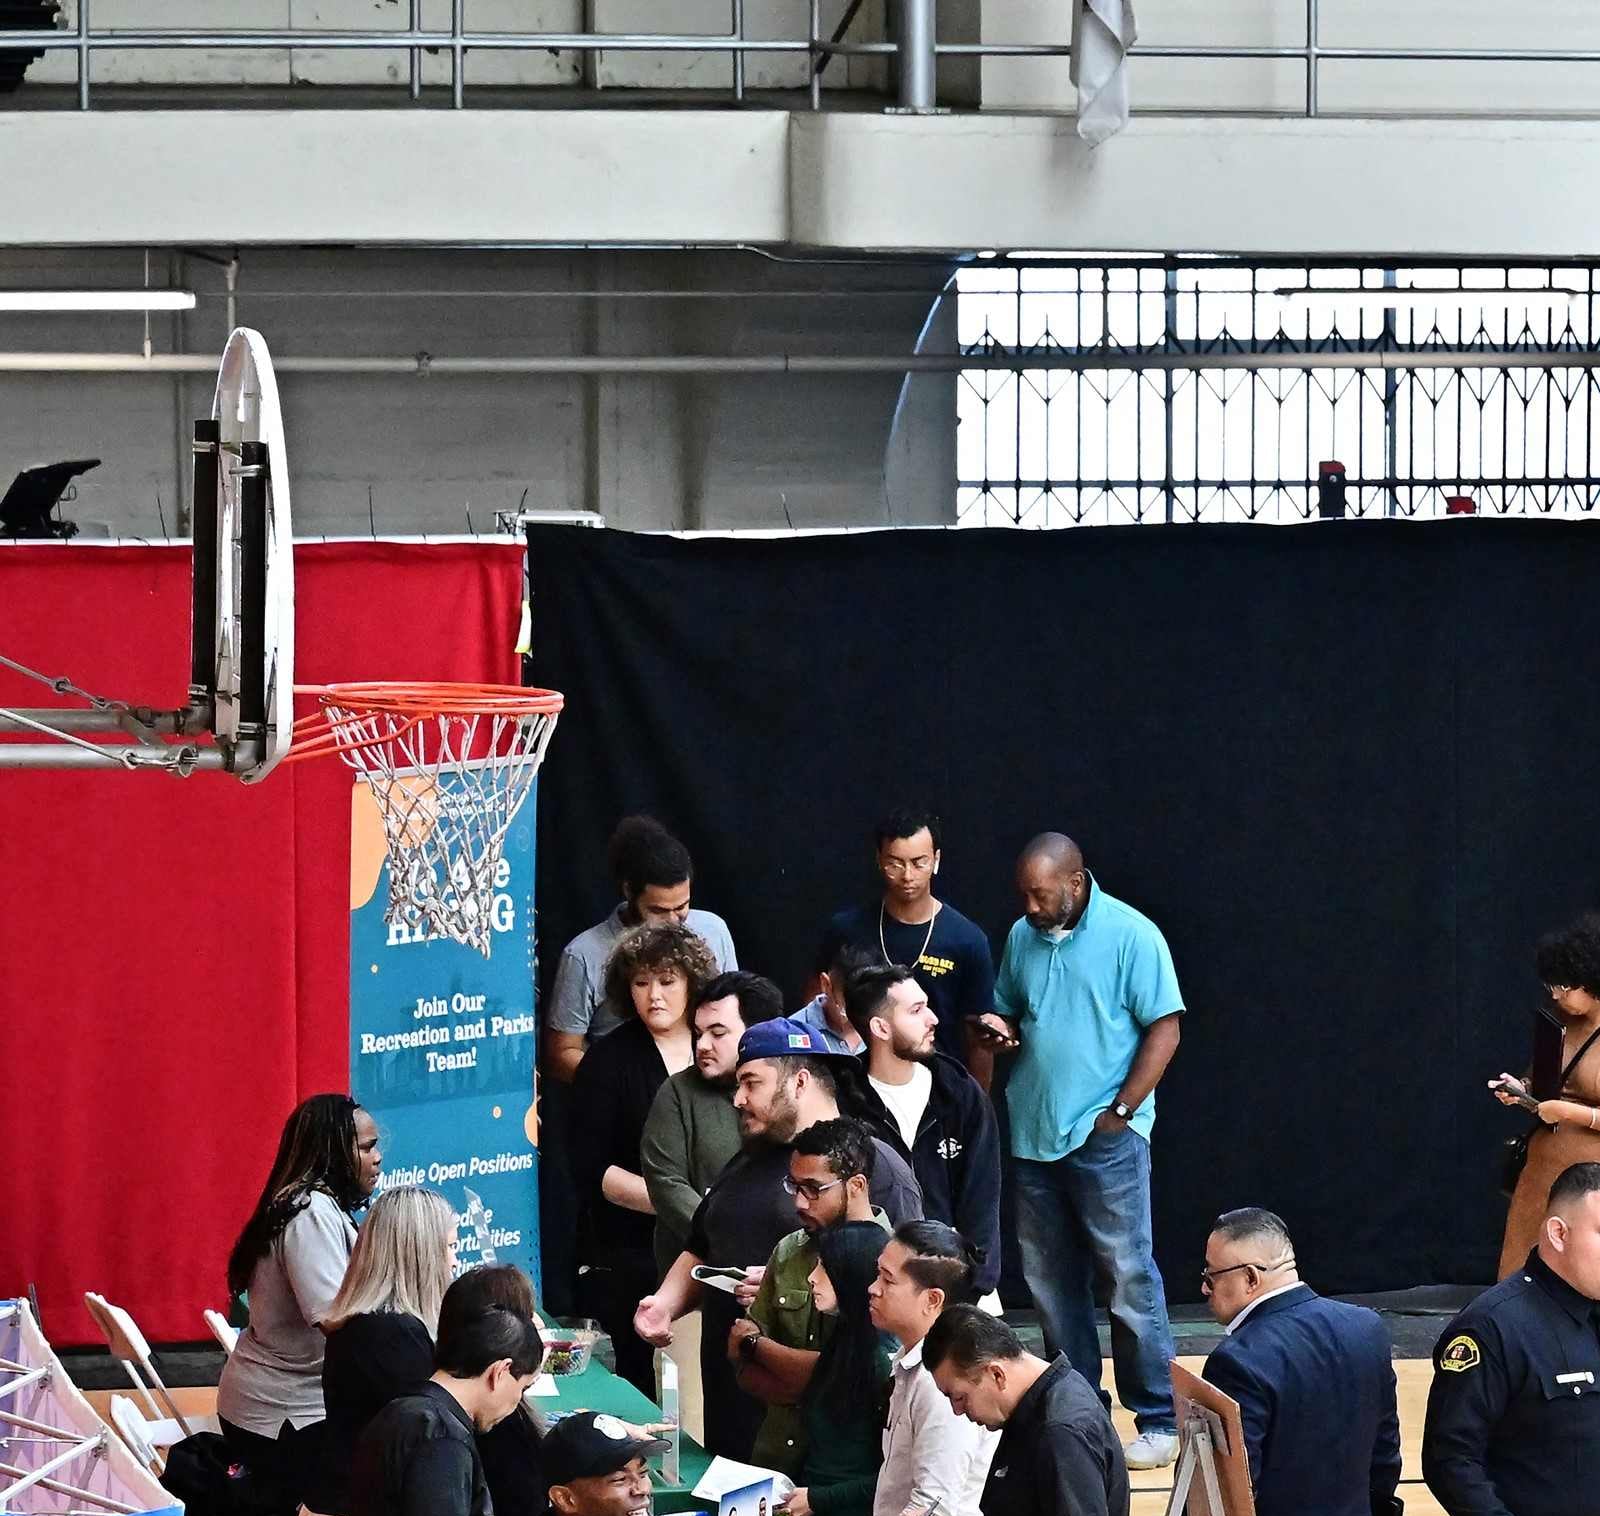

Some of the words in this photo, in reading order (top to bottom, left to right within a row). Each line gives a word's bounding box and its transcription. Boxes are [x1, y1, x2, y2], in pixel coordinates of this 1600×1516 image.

[413, 996, 448, 1019] Join
[451, 993, 486, 1013] Our
[360, 1025, 450, 1055] Recreation
[454, 1018, 487, 1042] and
[490, 1013, 535, 1037] Parks
[426, 1046, 477, 1073] Team!
[428, 1161, 466, 1186] Open
[468, 1151, 533, 1176] Positions
